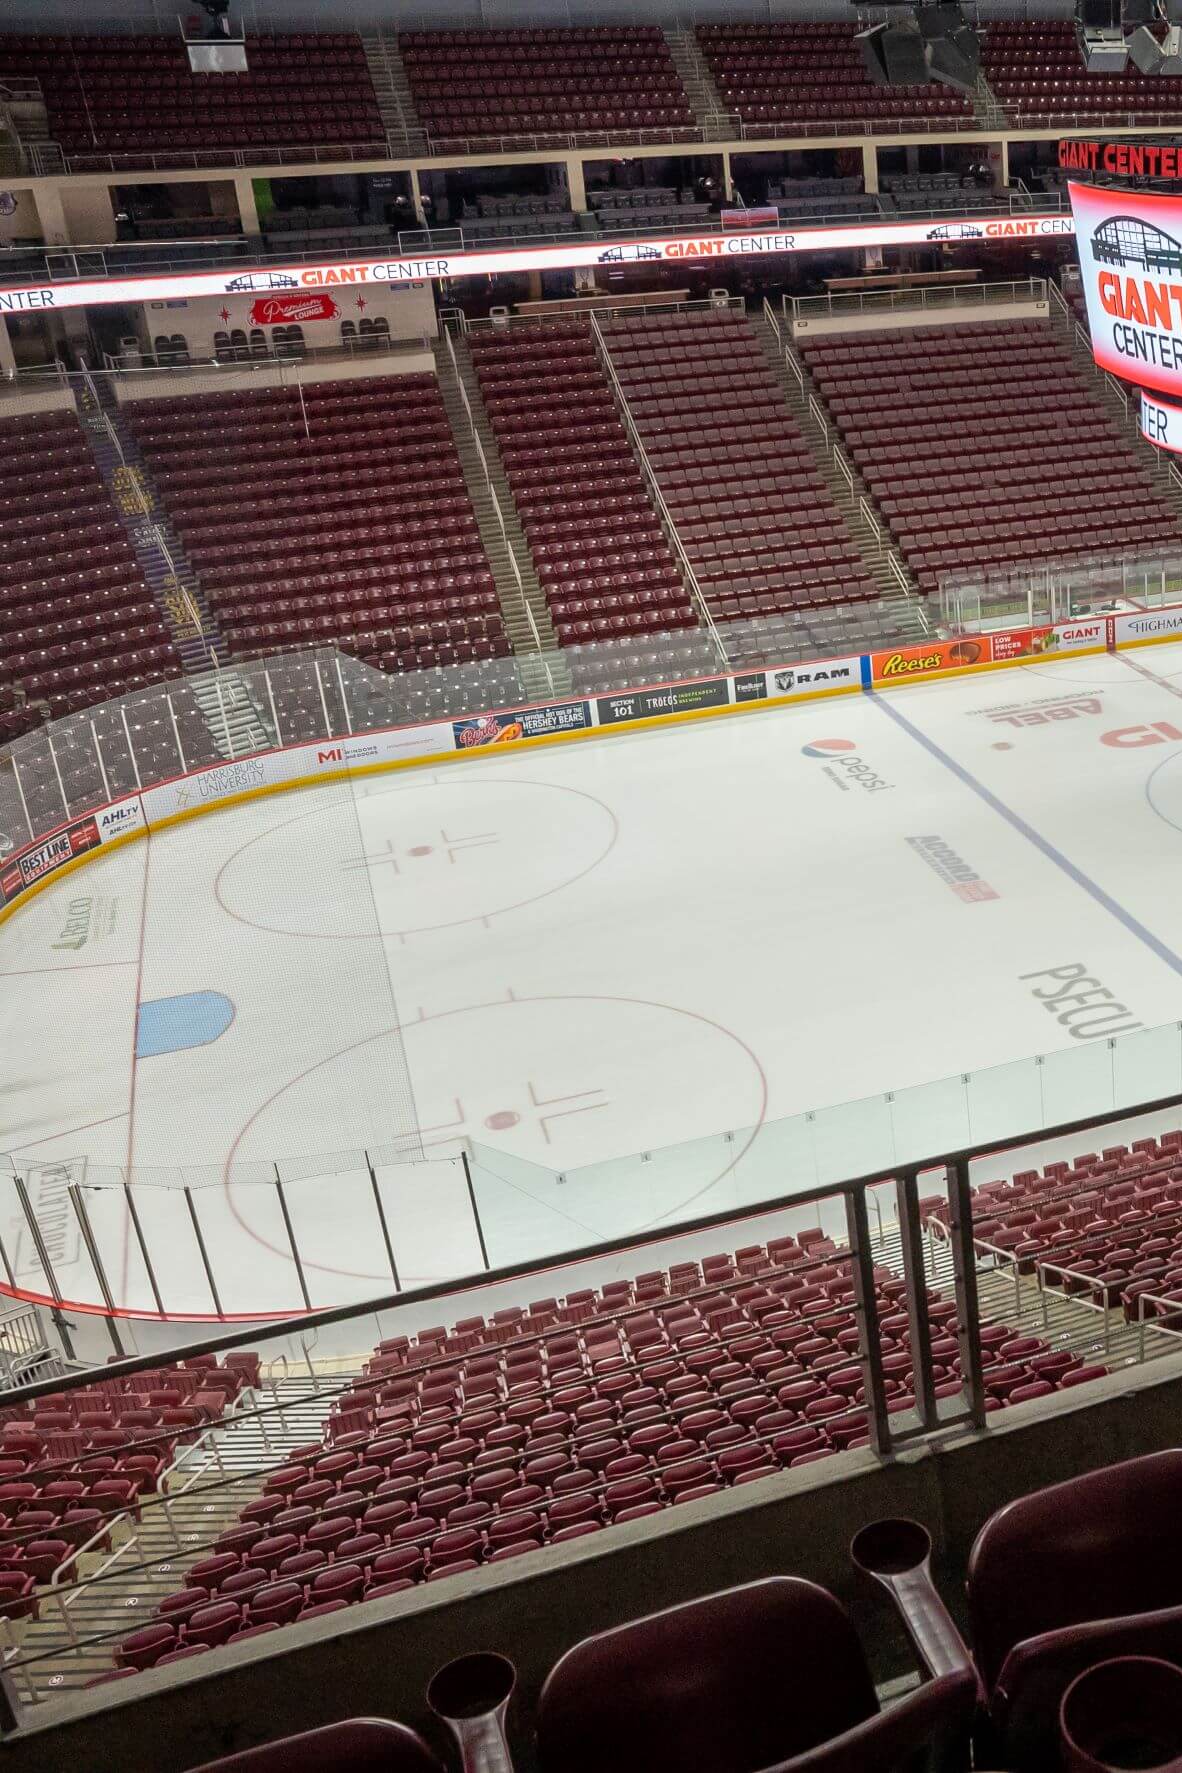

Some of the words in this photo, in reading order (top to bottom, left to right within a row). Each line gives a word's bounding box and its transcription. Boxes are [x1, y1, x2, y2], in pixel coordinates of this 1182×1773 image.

[1058, 141, 1101, 171] GIANT
[986, 221, 1039, 237] GIANT
[665, 239, 725, 258] GIANT
[728, 235, 795, 253] CENTER
[301, 266, 370, 286] GIANT
[373, 260, 449, 280] CENTER
[263, 299, 321, 322] Premium
[294, 306, 324, 320] LOUNGE
[1143, 400, 1169, 444] TER
[995, 636, 1011, 644] LOW
[1063, 626, 1101, 640] GIANT
[995, 642, 1022, 651] PRICES
[797, 667, 850, 684] RAM
[523, 716, 557, 729] HERSHEY
[559, 713, 584, 724] BEARS
[614, 705, 635, 718] 101
[991, 698, 1104, 728] ABEL
[317, 748, 342, 764] MI
[344, 745, 378, 755] WINDOWS
[198, 760, 264, 786] HARRISBURG
[200, 770, 265, 797] UNIVERSITY
[831, 755, 897, 793] pepsi
[21, 851, 46, 876] BEST
[46, 837, 69, 859] LINE
[1018, 962, 1145, 1040] PSECU
